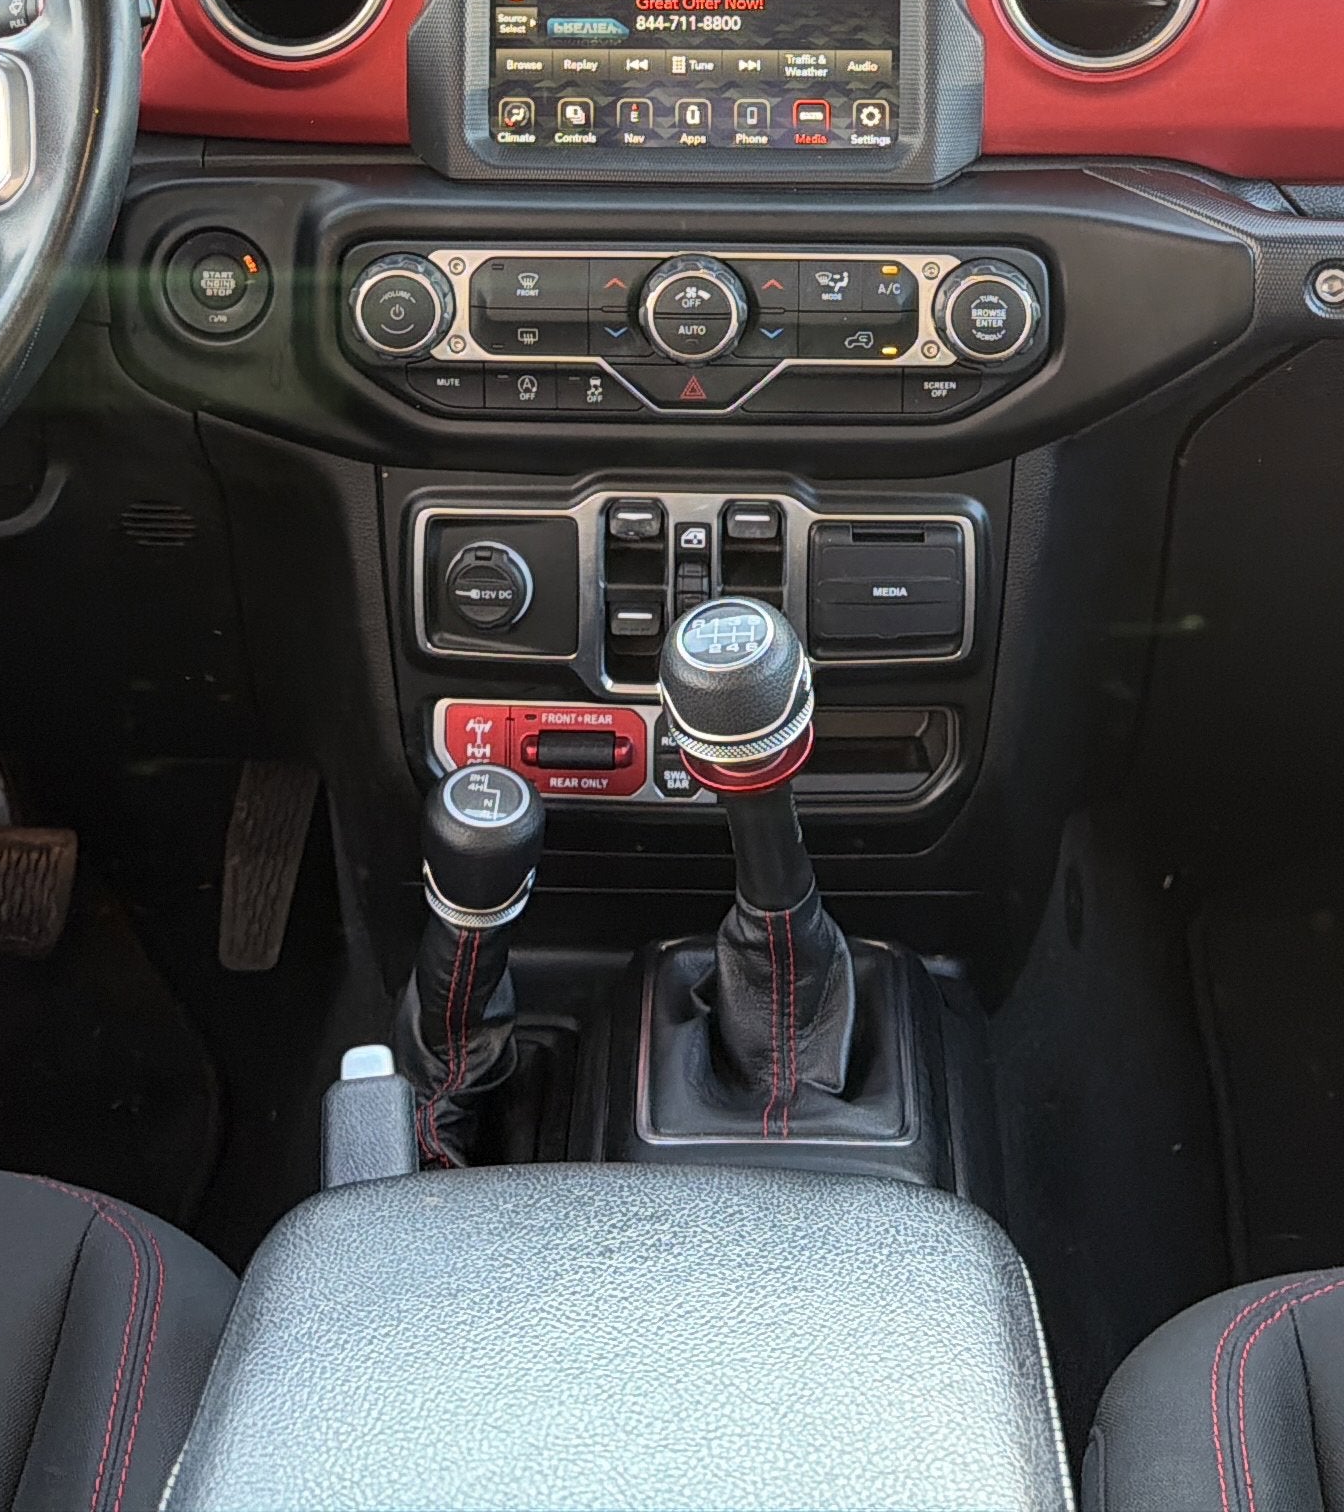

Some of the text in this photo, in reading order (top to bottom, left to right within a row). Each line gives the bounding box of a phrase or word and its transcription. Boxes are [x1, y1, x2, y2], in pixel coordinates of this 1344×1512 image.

[497, 14, 528, 23] Source
[636, 15, 741, 31] 844-711-8800
[9, 20, 26, 29] PULL
[499, 25, 527, 34] Select
[786, 54, 827, 65] Traffic &
[506, 60, 543, 70] Browse
[563, 59, 599, 72] Replay
[689, 60, 714, 71] Tune
[847, 61, 879, 73] Audio
[784, 66, 828, 78] Weather
[497, 132, 537, 144] Climate
[554, 132, 597, 144] Controls
[624, 133, 645, 144] Nav
[680, 133, 707, 146] Apps
[735, 134, 769, 145] Phone
[795, 134, 828, 145] Media
[850, 134, 891, 147] Settings
[202, 271, 234, 279] START
[206, 289, 233, 297] STOP
[516, 289, 540, 297] FRONT
[877, 283, 901, 295] A/C
[383, 290, 412, 300] VOLUME
[821, 293, 843, 301] MODE
[979, 294, 1000, 304] TUNE
[681, 298, 702, 308] OFF
[971, 308, 1007, 317] BROWSE
[976, 319, 1004, 328] ENTER
[678, 325, 706, 336] AUTO
[437, 378, 460, 387] MUTE
[923, 381, 957, 390] SCREEN
[519, 392, 536, 401] OFF
[586, 394, 603, 403] OFF
[931, 390, 948, 398] OFF
[481, 590, 513, 599] 12V DC
[872, 586, 908, 597] MEDIA
[709, 643, 722, 653] 2
[726, 643, 740, 652] 4
[664, 770, 691, 780] SWA
[550, 778, 608, 789] REAR ONLY
[667, 780, 690, 789] BAR
[483, 799, 493, 808] N
